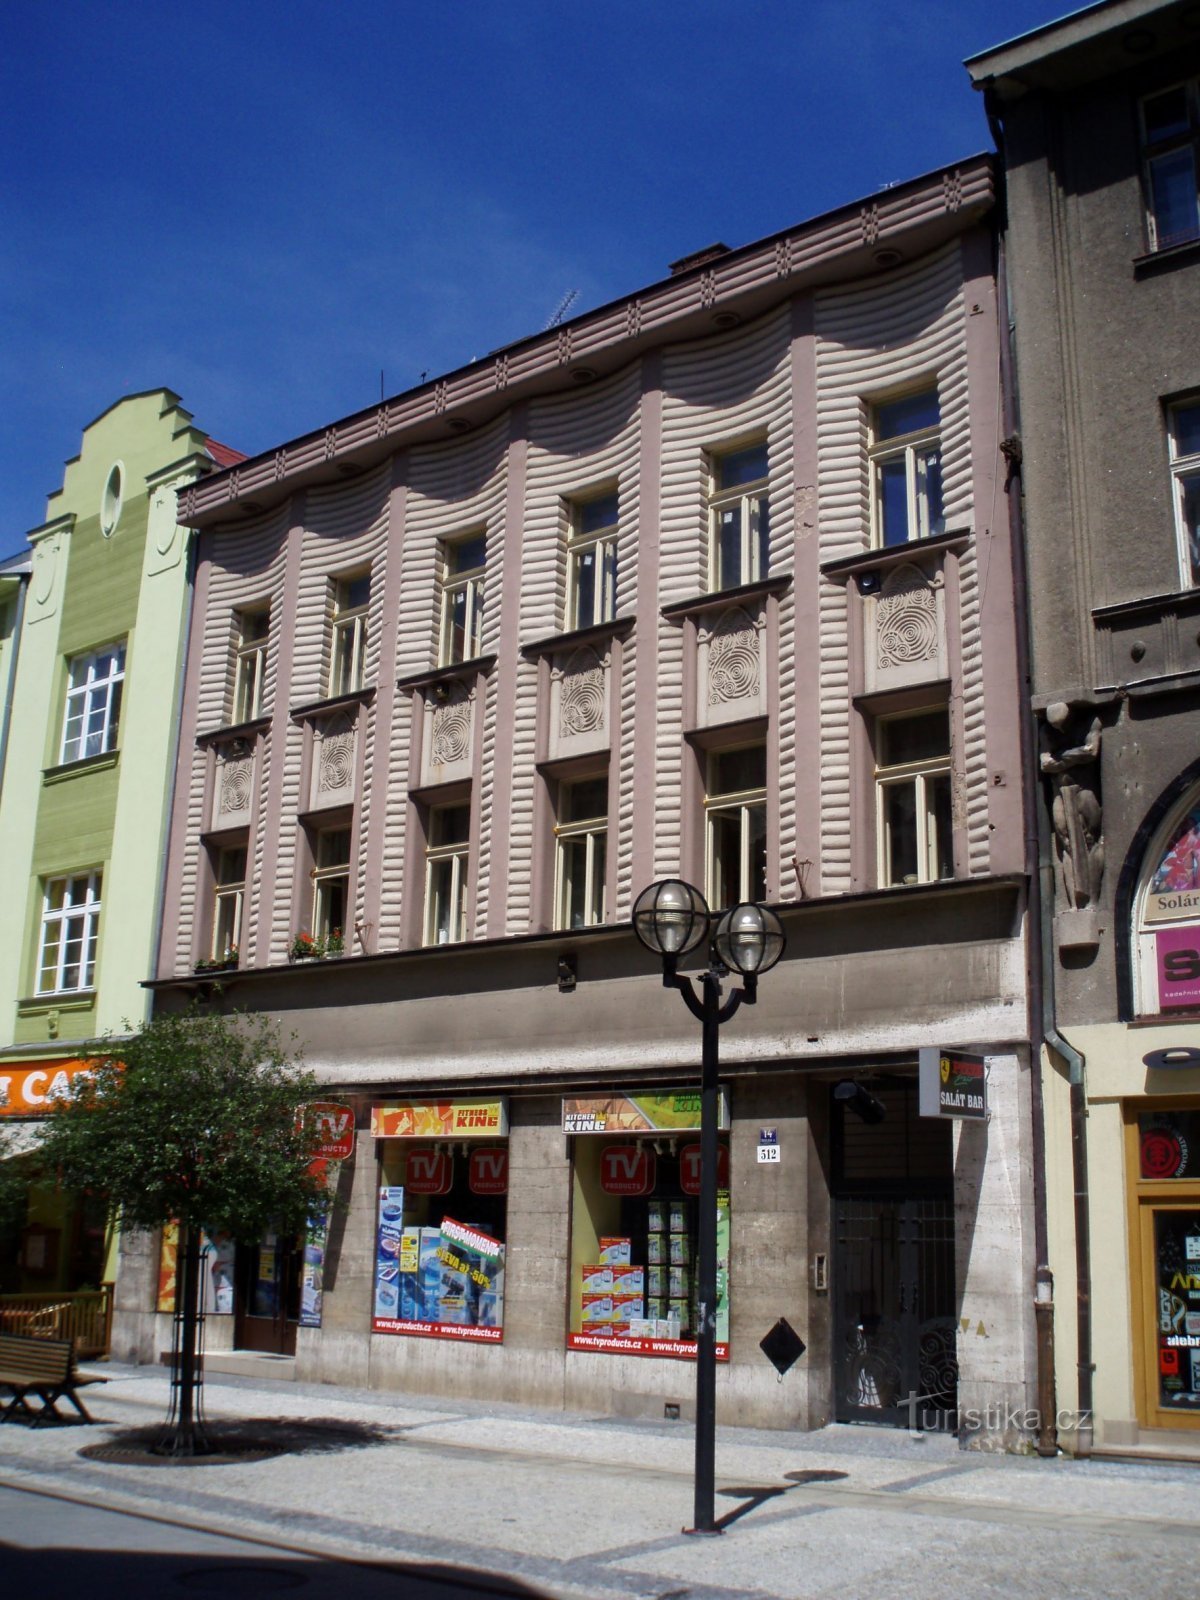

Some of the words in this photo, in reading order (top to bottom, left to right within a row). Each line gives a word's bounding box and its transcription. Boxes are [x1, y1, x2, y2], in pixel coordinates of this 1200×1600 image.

[673, 1100, 702, 1112] KIN
[940, 1089, 966, 1107] SALÁT
[967, 1095, 984, 1109] BAR
[457, 1109, 488, 1117] FITNESS
[565, 1112, 596, 1121] KITCHEN
[456, 1116, 499, 1128] KING
[564, 1120, 606, 1132] KING
[760, 1149, 777, 1160] 512
[411, 1155, 438, 1179] TV
[475, 1155, 505, 1178] TV
[606, 1154, 641, 1178] TV
[605, 1182, 641, 1190] PRODUCTS
[436, 1246, 460, 1269] SLEVA
[376, 1320, 432, 1332] www.tvproducts.cz
[441, 1326, 500, 1339] www.tvproducts.cz
[573, 1335, 642, 1349] www.tvproducts.cz
[652, 1342, 725, 1355] www.tvprodcz
